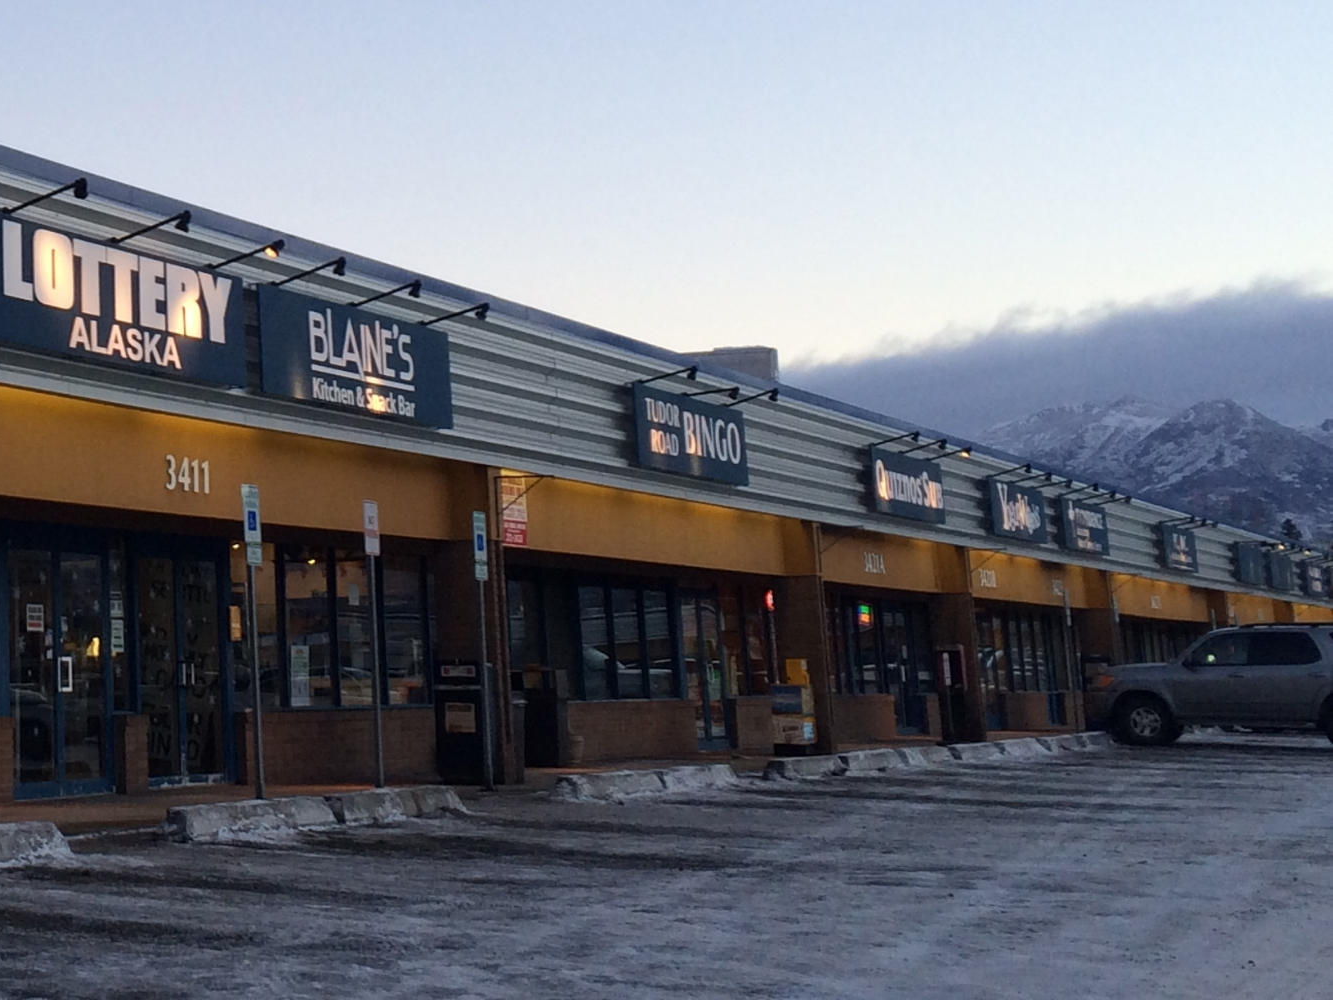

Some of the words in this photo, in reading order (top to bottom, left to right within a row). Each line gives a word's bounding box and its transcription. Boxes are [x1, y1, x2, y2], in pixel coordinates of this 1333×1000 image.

[2, 219, 232, 344] LOTTERY
[69, 316, 182, 370] ALASKA
[308, 307, 415, 381] BLAINE'S
[312, 376, 354, 406] Kitchen
[356, 385, 365, 408] &
[397, 394, 416, 417] Bar
[644, 397, 681, 428] TUDOR
[650, 428, 680, 456] ROAD
[682, 410, 742, 464] BINGO
[166, 454, 210, 494] 3411
